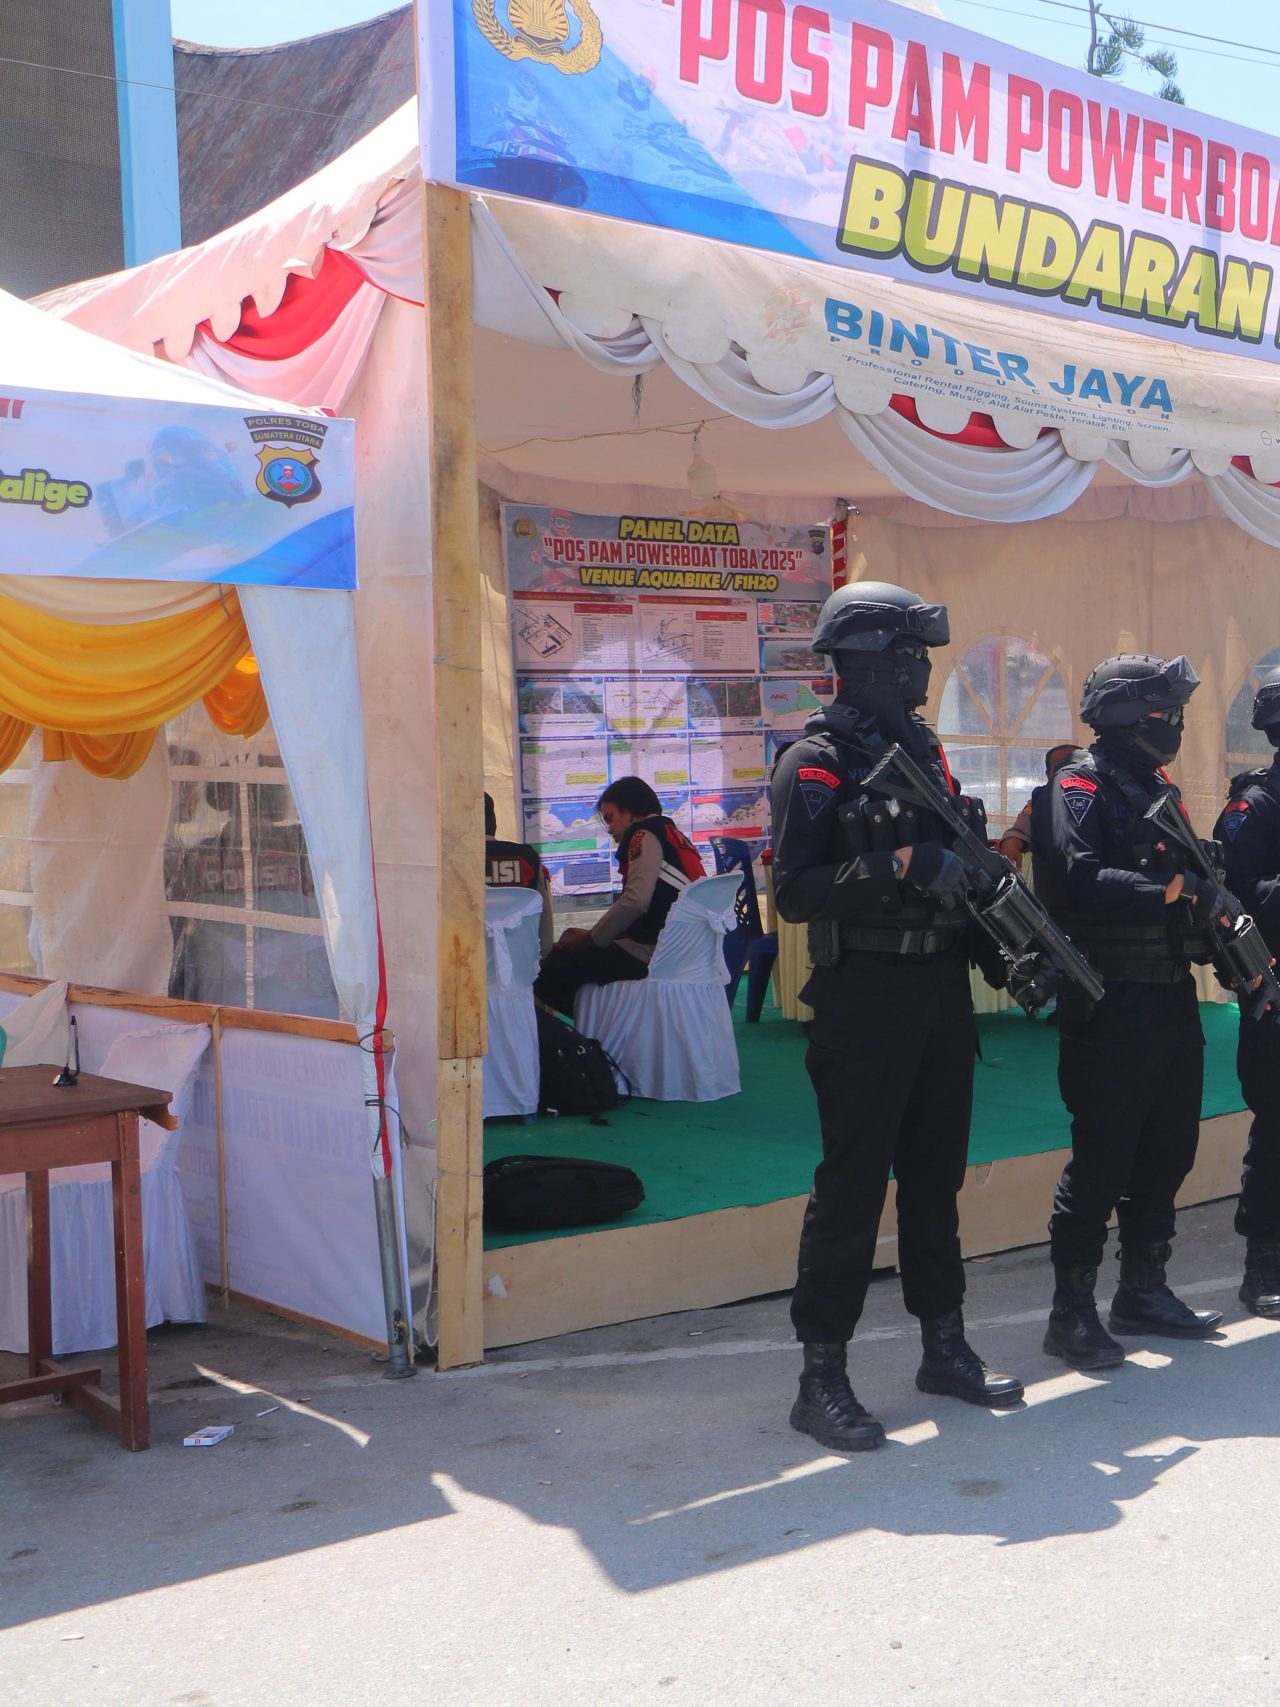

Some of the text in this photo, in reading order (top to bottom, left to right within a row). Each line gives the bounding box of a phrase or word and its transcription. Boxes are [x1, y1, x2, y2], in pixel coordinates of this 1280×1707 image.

[848, 21, 991, 164] PAM
[837, 157, 1272, 343] BUNDARAN
[825, 298, 1173, 412] BINTER JAYA
[925, 376, 963, 390] Rental
[1015, 397, 1047, 410] Sound
[989, 399, 1009, 409] Alat
[1012, 404, 1033, 415] Alat
[248, 417, 325, 434] POLRES TOBA
[253, 431, 321, 446] SUMATERA UTARA
[619, 518, 740, 544] PANEL DATA
[543, 537, 803, 572] "POS PAM POWERBOAT TOBA 2025"
[580, 568, 635, 586] VENUE
[637, 570, 721, 591] AQUABIKE
[722, 576, 733, 591] /
